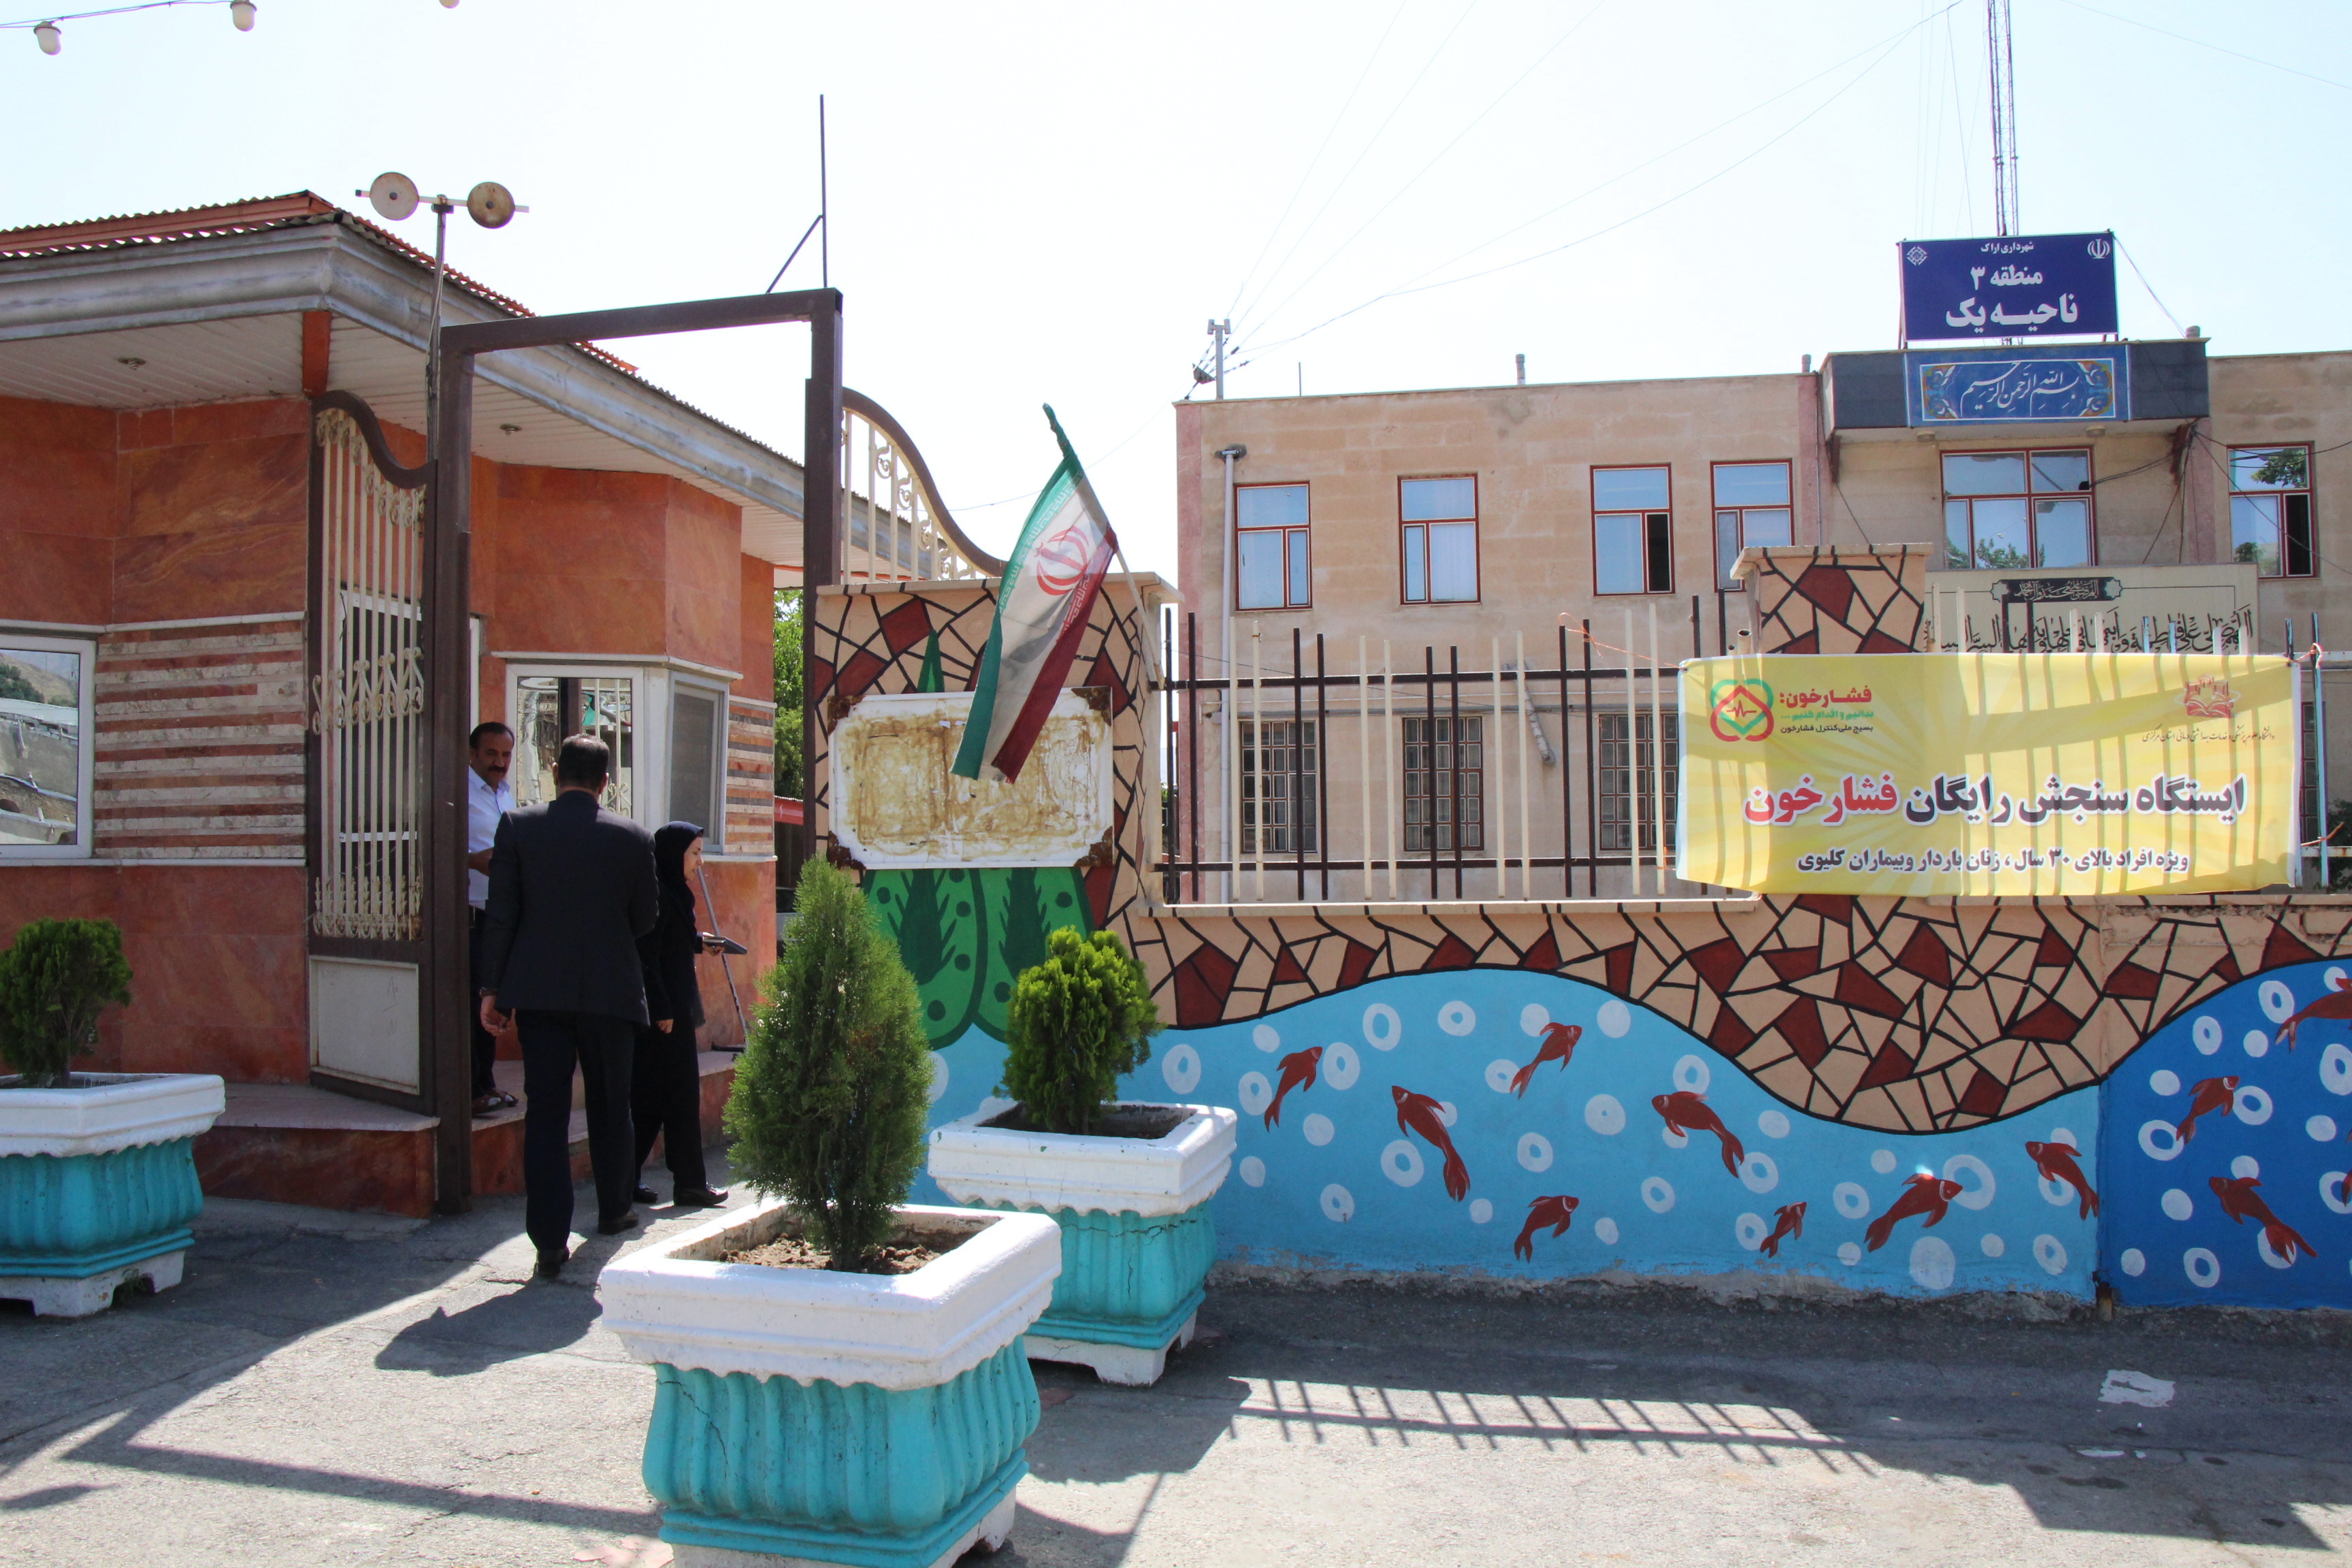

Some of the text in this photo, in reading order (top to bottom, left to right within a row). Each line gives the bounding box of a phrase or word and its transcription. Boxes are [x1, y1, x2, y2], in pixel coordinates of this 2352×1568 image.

[1980, 241, 2034, 254] شهرداری اراک
[1970, 264, 2043, 290] منطقه ۳
[1946, 293, 2078, 333] ناحیه یک
[1906, 776, 2010, 823] رایگان
[2018, 776, 2129, 823] سنجش
[2136, 777, 2244, 821] ایستگاه
[1798, 849, 1846, 872] کلیوی
[1917, 849, 1963, 872] باردار
[1965, 849, 2000, 872] زنان
[2014, 849, 2044, 871] سال
[2048, 849, 2070, 868] ۳۰
[2076, 849, 2112, 872] بالای
[2116, 849, 2153, 872] افراد
[2155, 852, 2188, 872] ویژه
